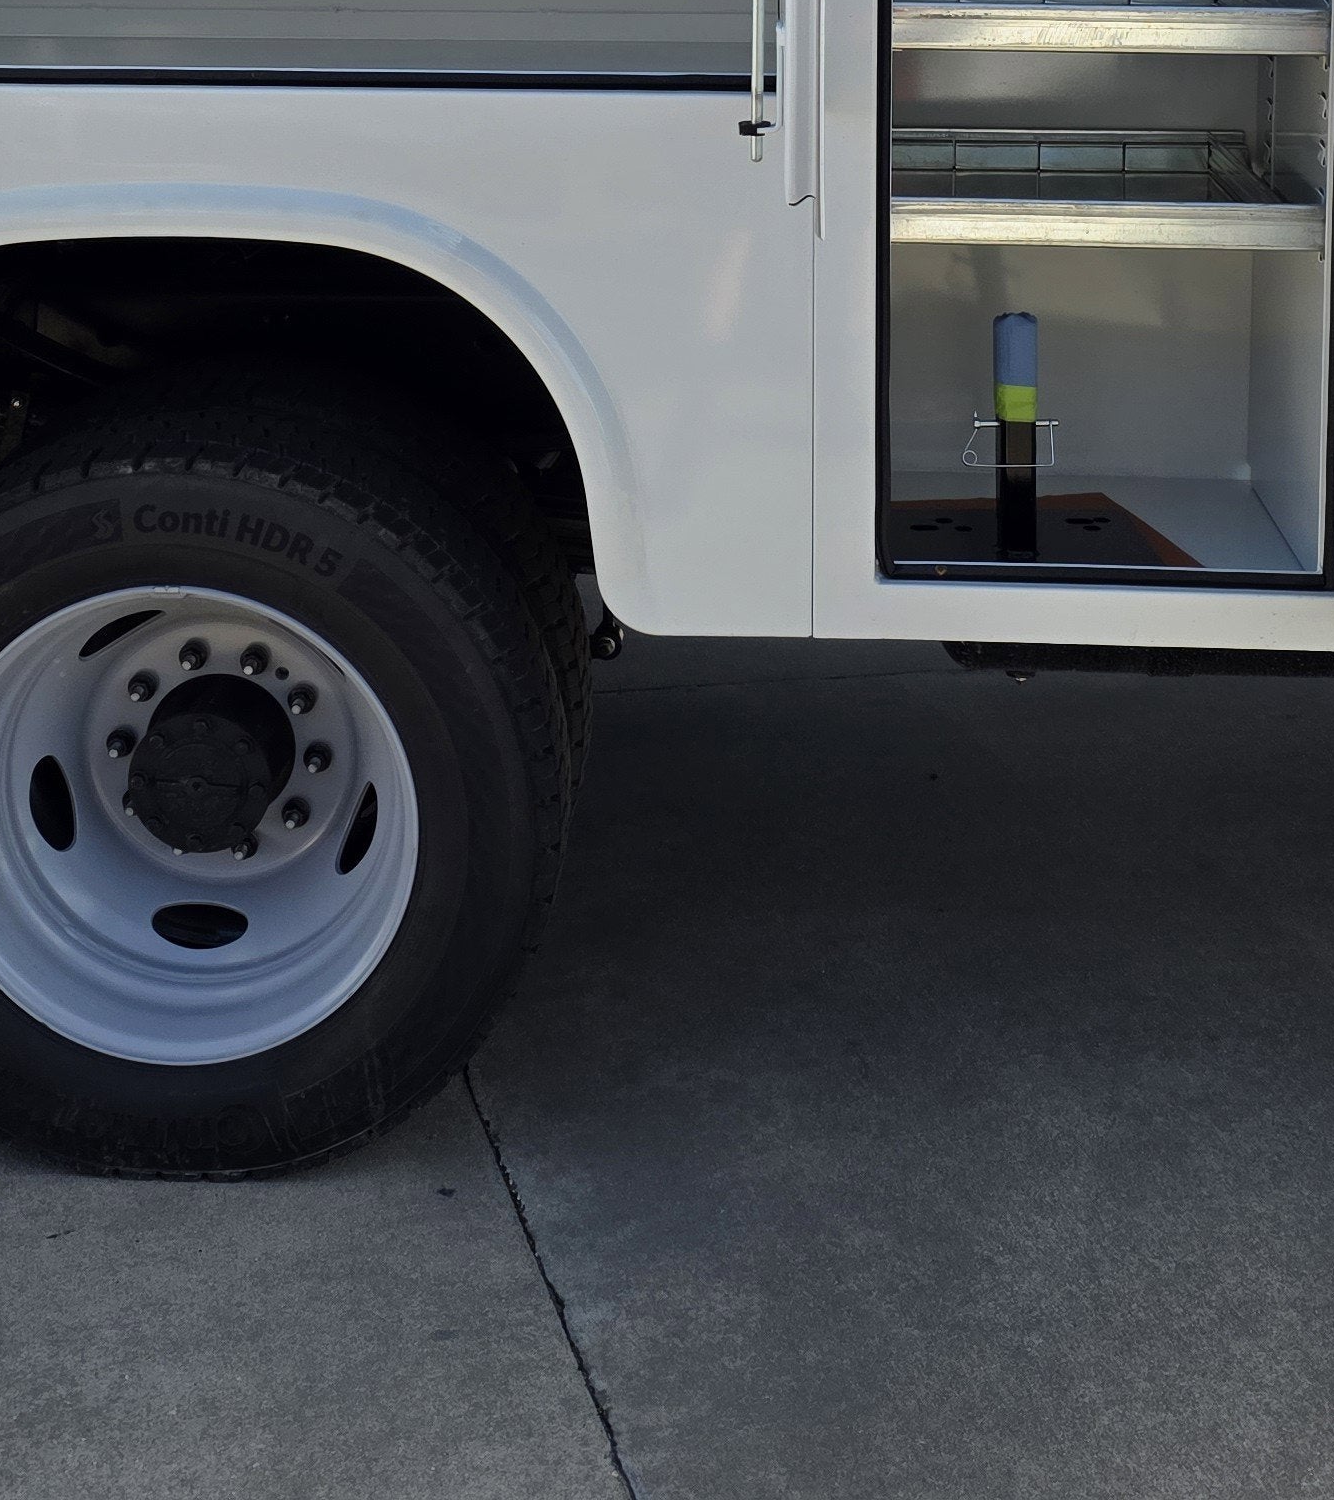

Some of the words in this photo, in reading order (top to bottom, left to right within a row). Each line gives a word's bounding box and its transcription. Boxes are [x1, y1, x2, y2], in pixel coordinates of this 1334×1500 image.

[132, 503, 232, 539] Conti
[234, 512, 315, 566] HDR
[313, 547, 344, 577] 5
